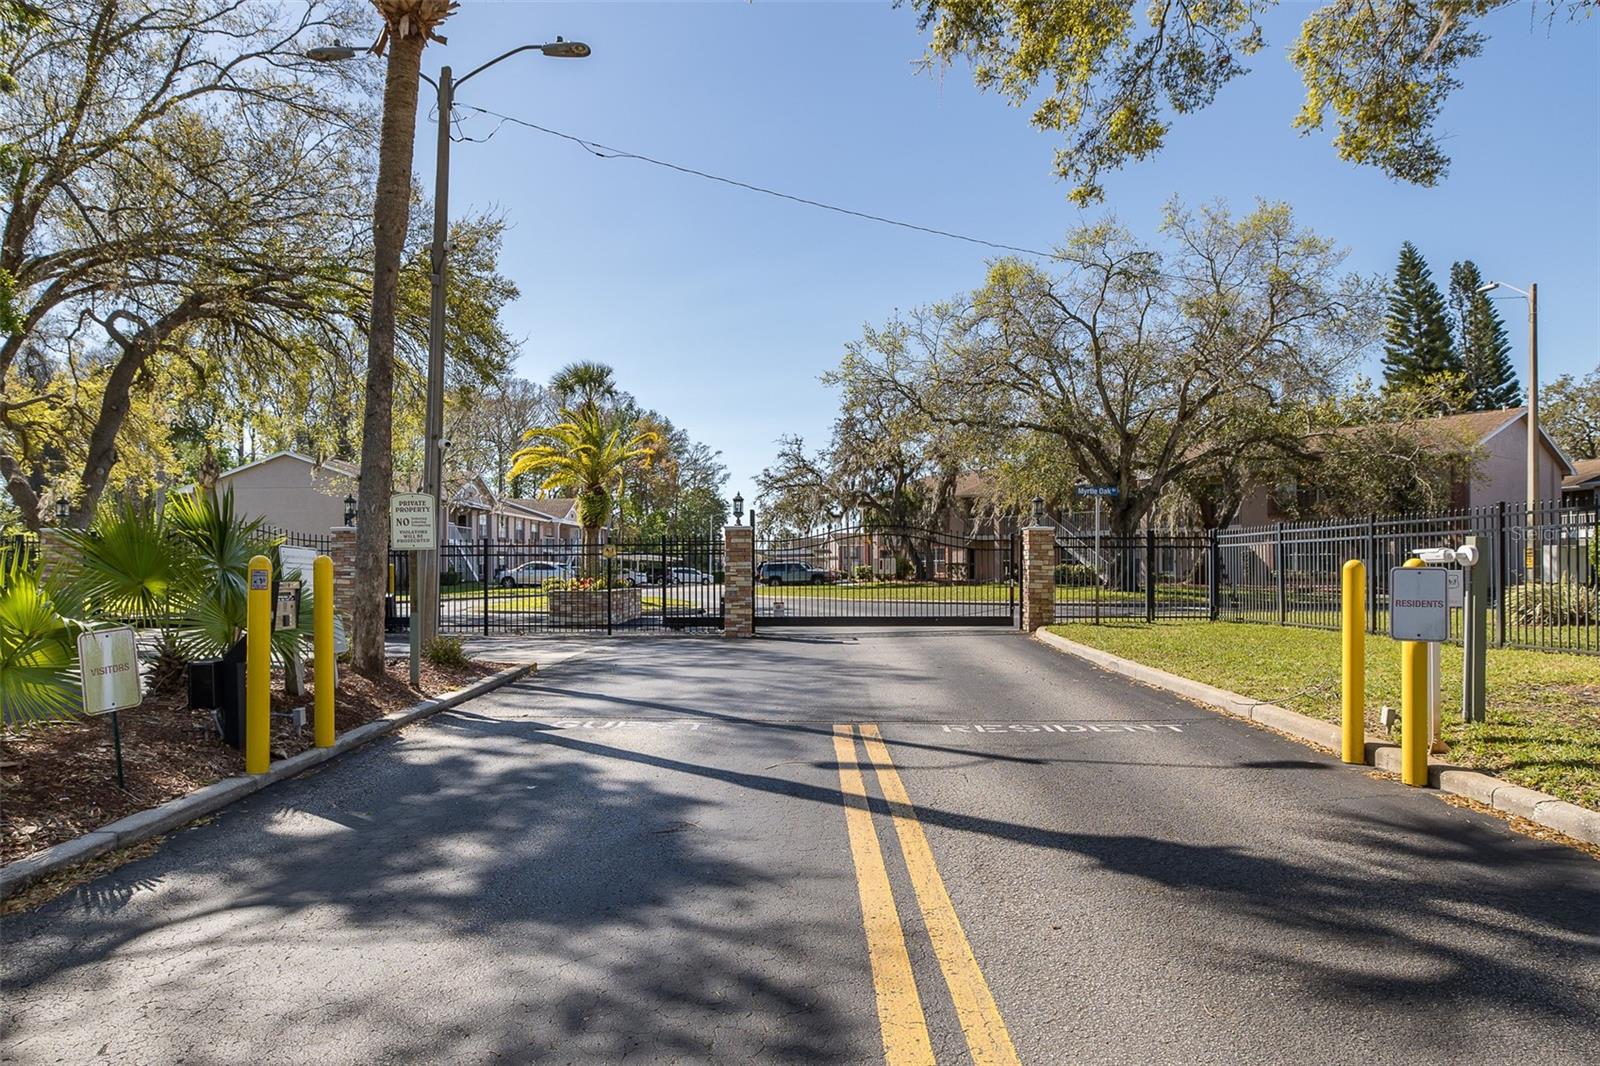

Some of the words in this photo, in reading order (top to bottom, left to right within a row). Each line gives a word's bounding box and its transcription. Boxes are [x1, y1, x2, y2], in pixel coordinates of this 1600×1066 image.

[1077, 487, 1098, 497] Myrtle
[1098, 487, 1112, 495] Oak
[396, 517, 410, 527] NO
[1395, 599, 1444, 609] RESIDENTS
[90, 662, 130, 677] VISITORS
[941, 724, 1184, 733] RESIDENT
